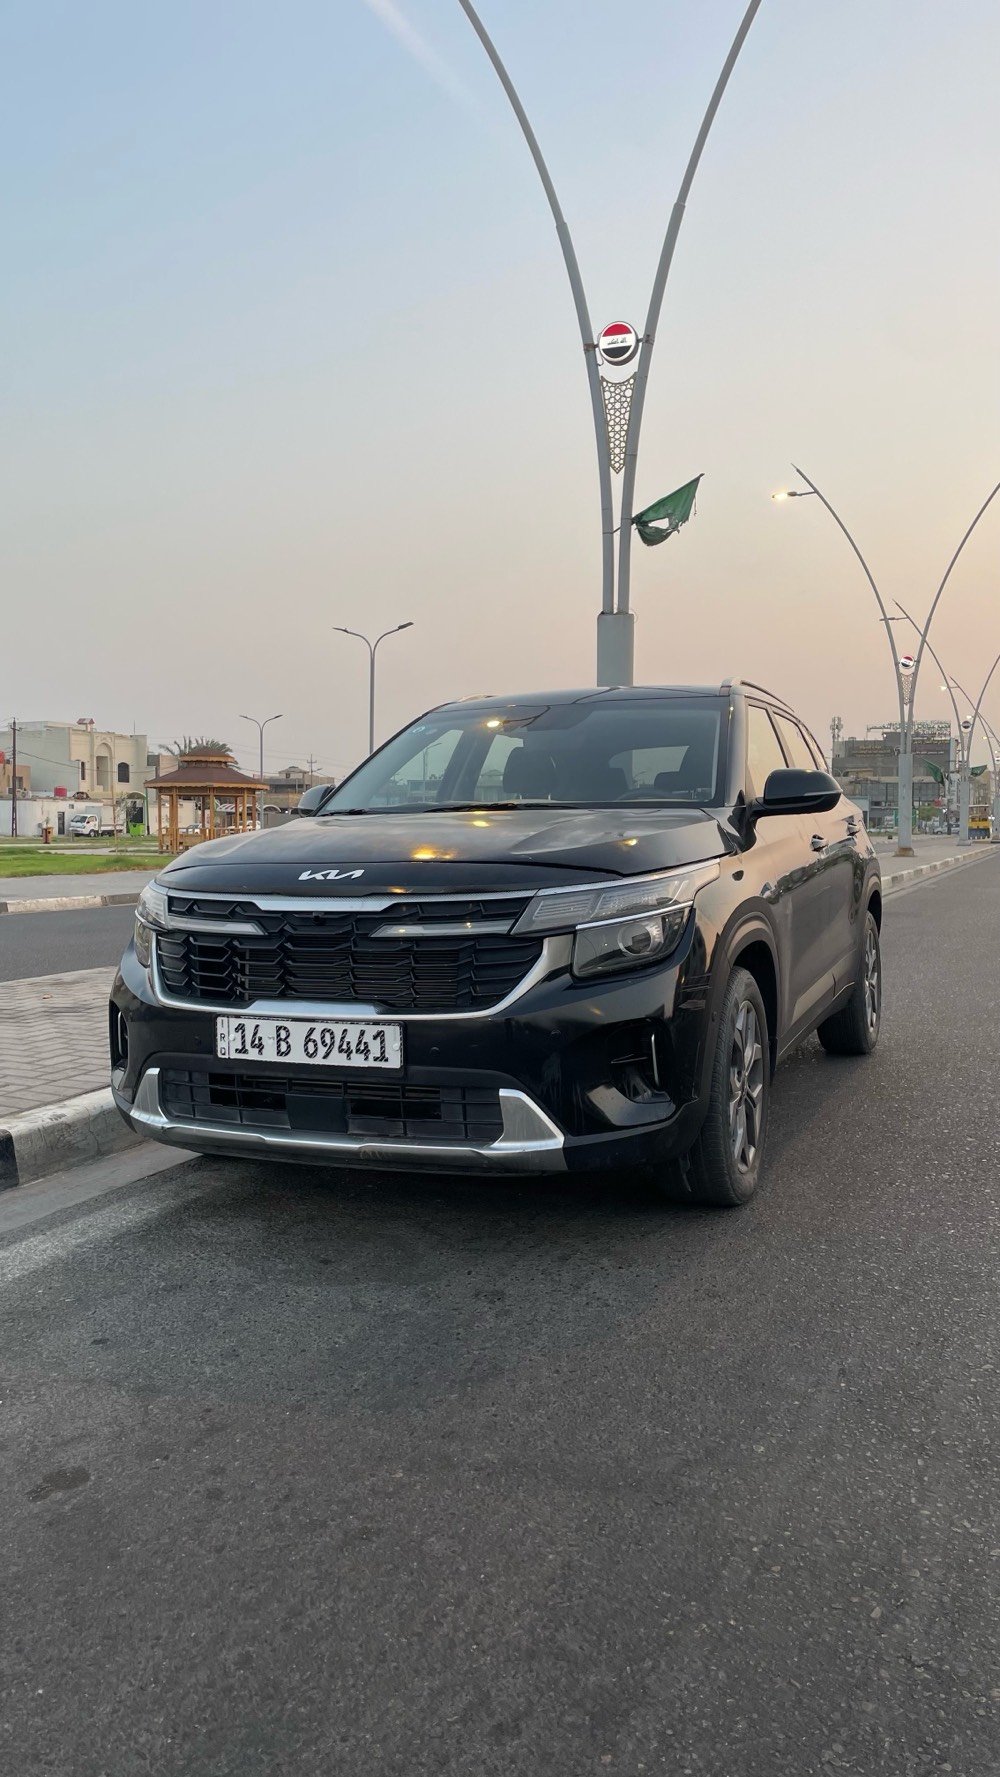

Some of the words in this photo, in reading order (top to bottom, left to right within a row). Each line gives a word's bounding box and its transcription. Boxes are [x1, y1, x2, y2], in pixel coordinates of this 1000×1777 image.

[298, 869, 365, 881] KIA
[234, 1022, 265, 1056] 14
[275, 1025, 292, 1057] B
[303, 1027, 389, 1062] 69441
